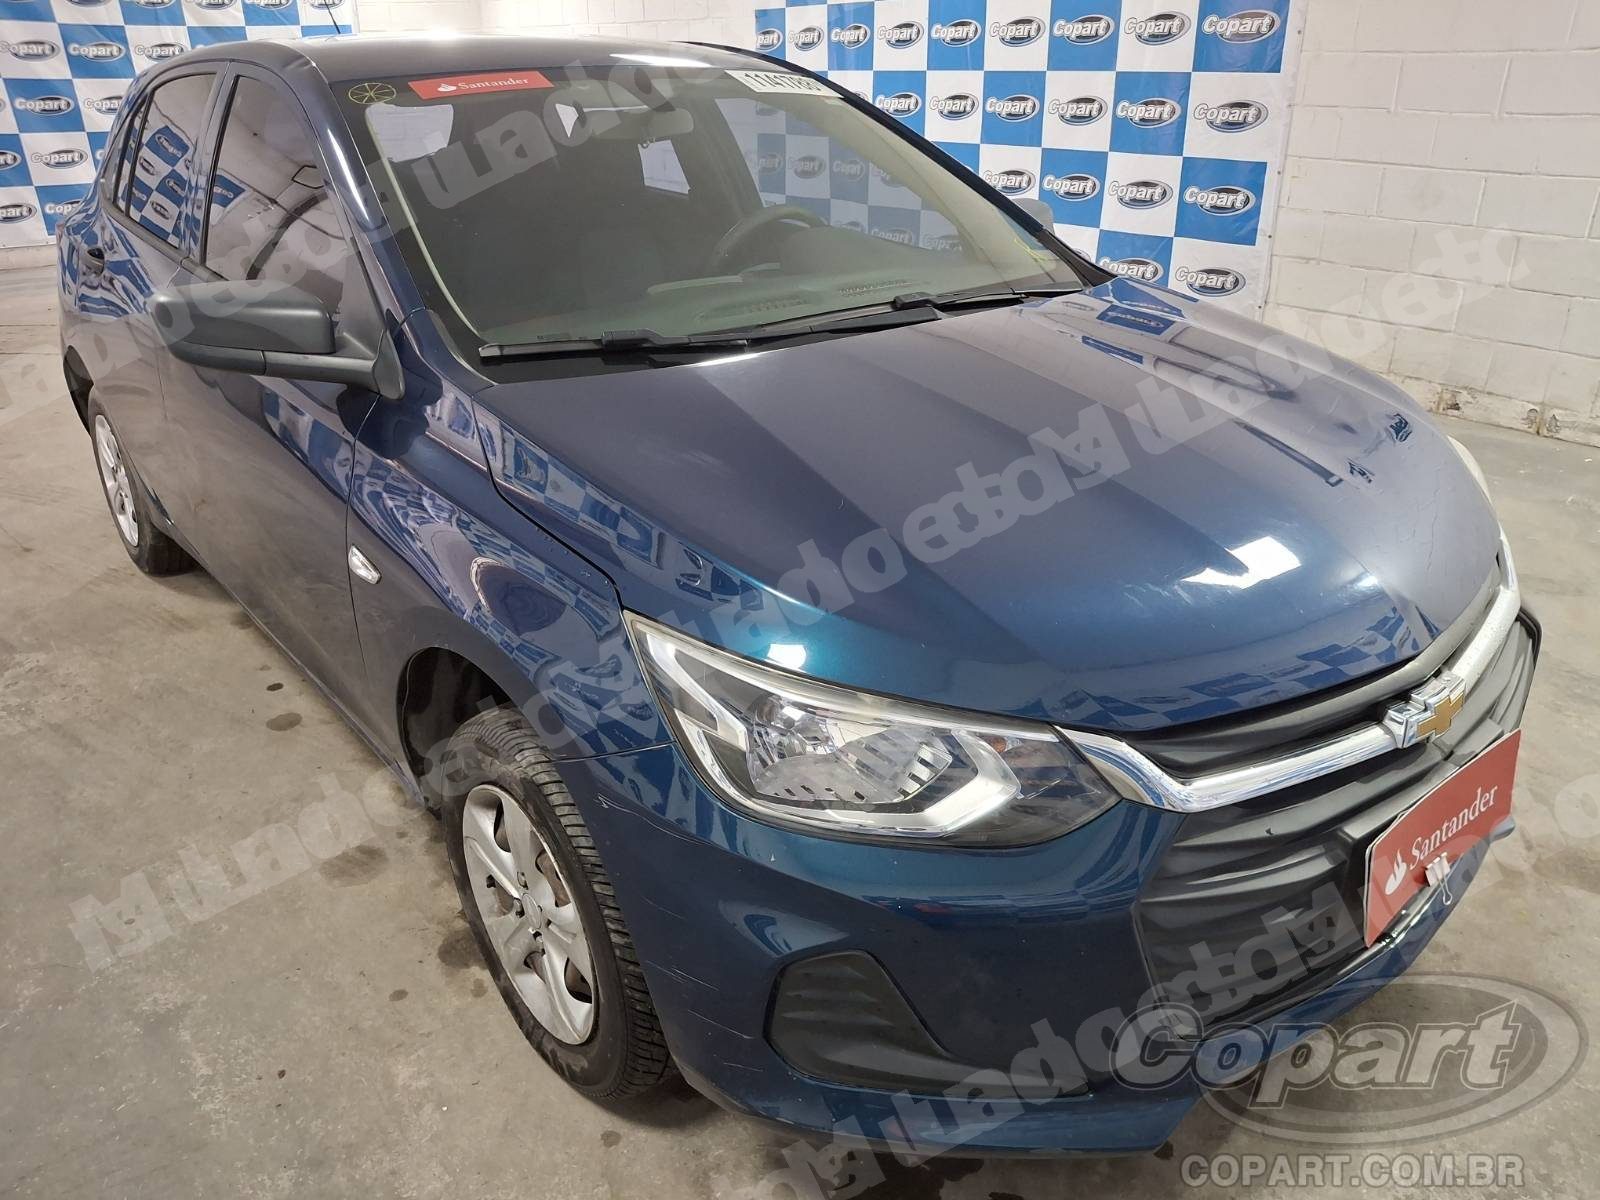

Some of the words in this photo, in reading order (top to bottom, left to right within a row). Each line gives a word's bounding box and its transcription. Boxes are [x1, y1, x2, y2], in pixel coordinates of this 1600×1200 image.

[831, 27, 866, 43] Copart
[878, 25, 918, 44] Copart
[931, 23, 975, 42] Copart
[989, 21, 1038, 41] Copart
[1053, 18, 1108, 39] Copart
[1124, 16, 1182, 38] Copart
[1202, 15, 1273, 36] Copart
[788, 30, 820, 46] Copart
[0, 41, 51, 58] Copart
[69, 42, 119, 58] Copart
[135, 44, 181, 58] Copart
[458, 77, 529, 90] Santander
[14, 97, 68, 111] Copart
[876, 95, 918, 113] Copart
[929, 95, 976, 114] Copart
[985, 97, 1035, 116] Copart
[1048, 98, 1100, 119] Copart
[1116, 100, 1173, 122] Copart
[1193, 103, 1260, 124] Copart
[31, 152, 80, 165] Copart
[983, 170, 1029, 190] Copart
[1042, 174, 1095, 195] Copart
[1107, 180, 1165, 203] Copart
[1184, 186, 1252, 209] Copart
[1174, 266, 1237, 290] Copart
[1409, 785, 1498, 871] Santander
